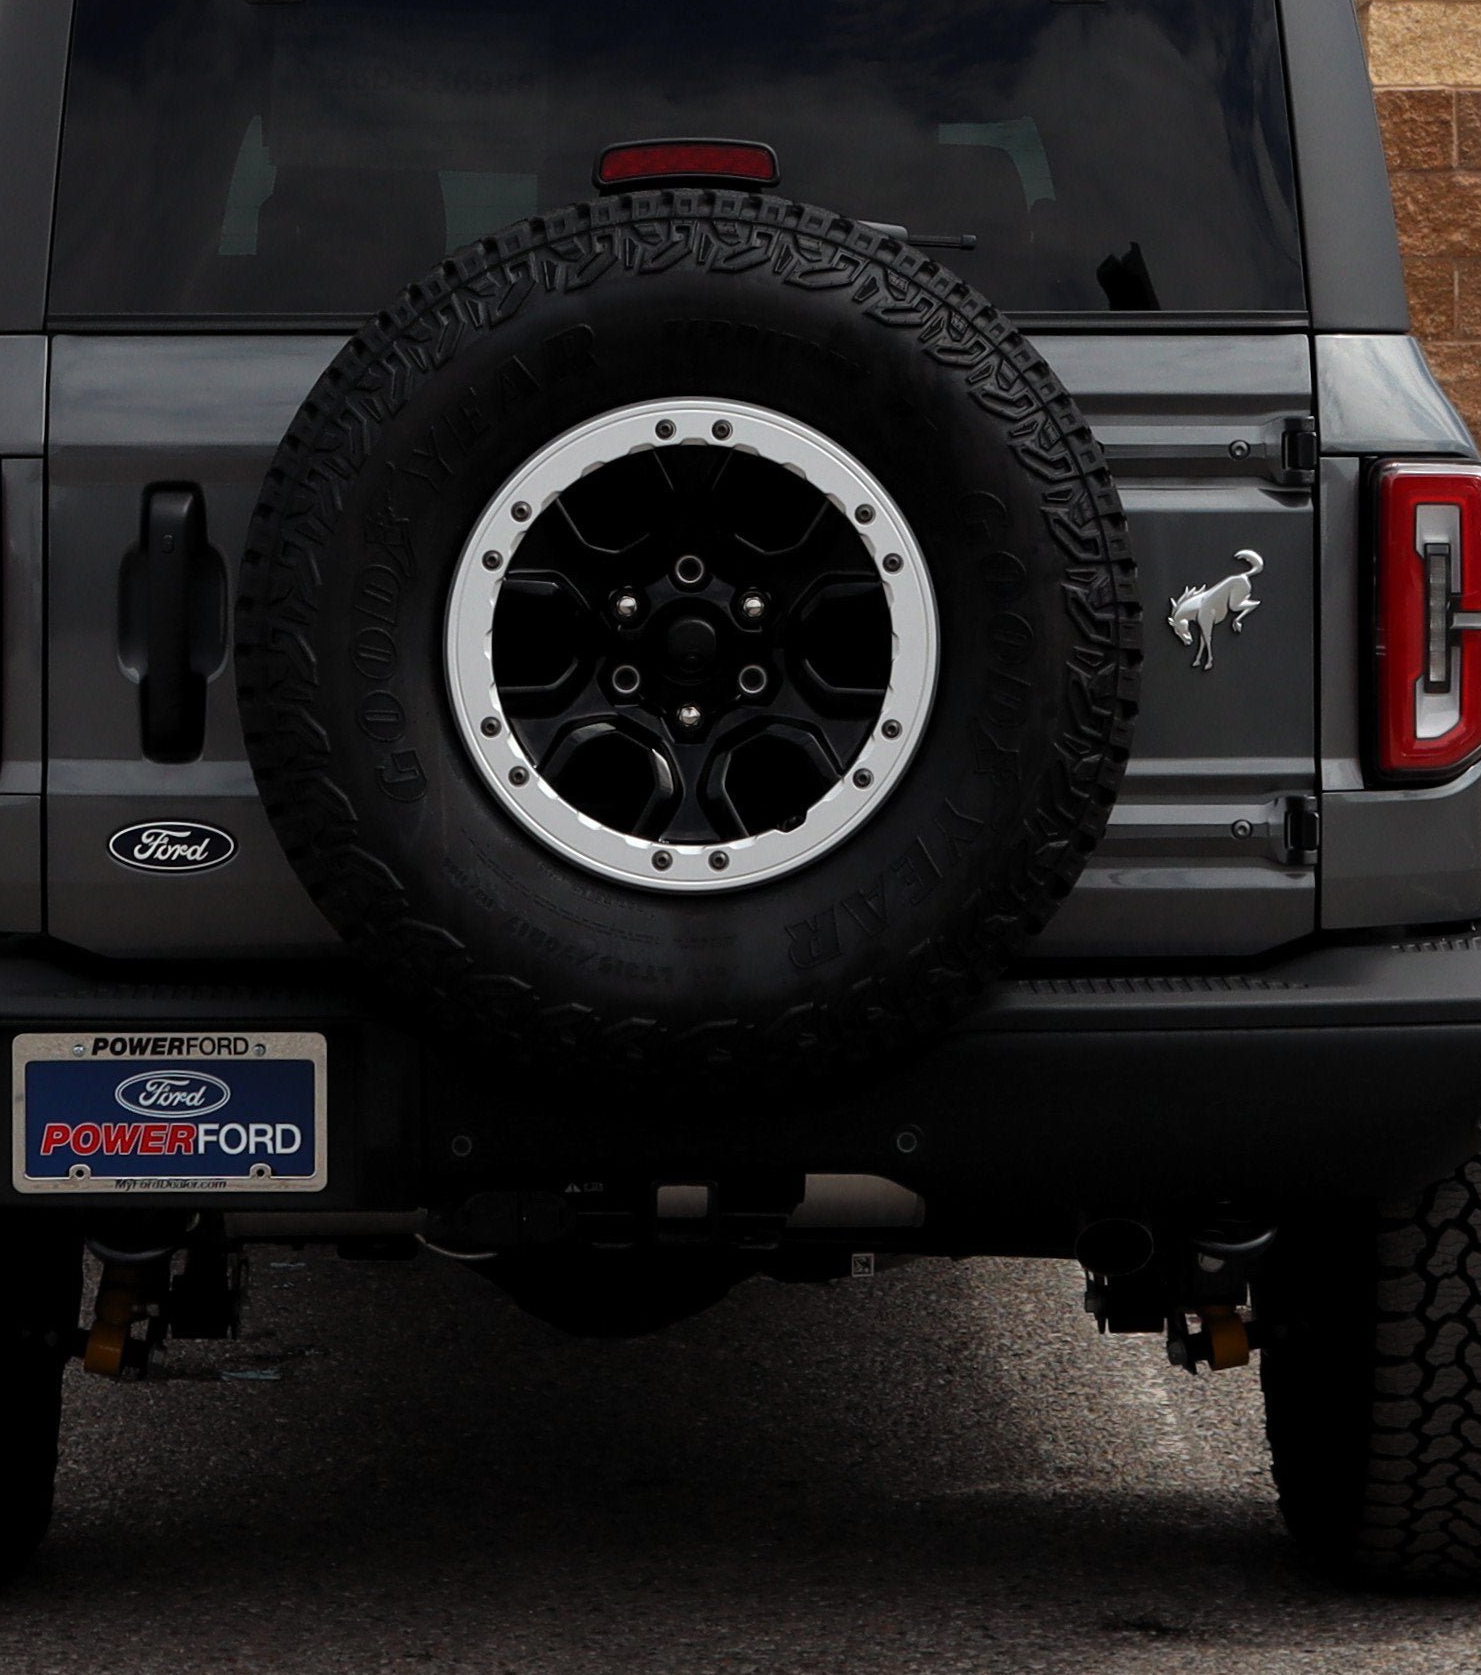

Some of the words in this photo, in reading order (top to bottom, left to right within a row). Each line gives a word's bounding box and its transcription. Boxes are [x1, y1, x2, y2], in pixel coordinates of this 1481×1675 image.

[133, 828, 211, 861] Ford
[91, 1036, 249, 1056] POWERFORD
[137, 1079, 207, 1107] Ford
[40, 1123, 302, 1155] POWERFORD
